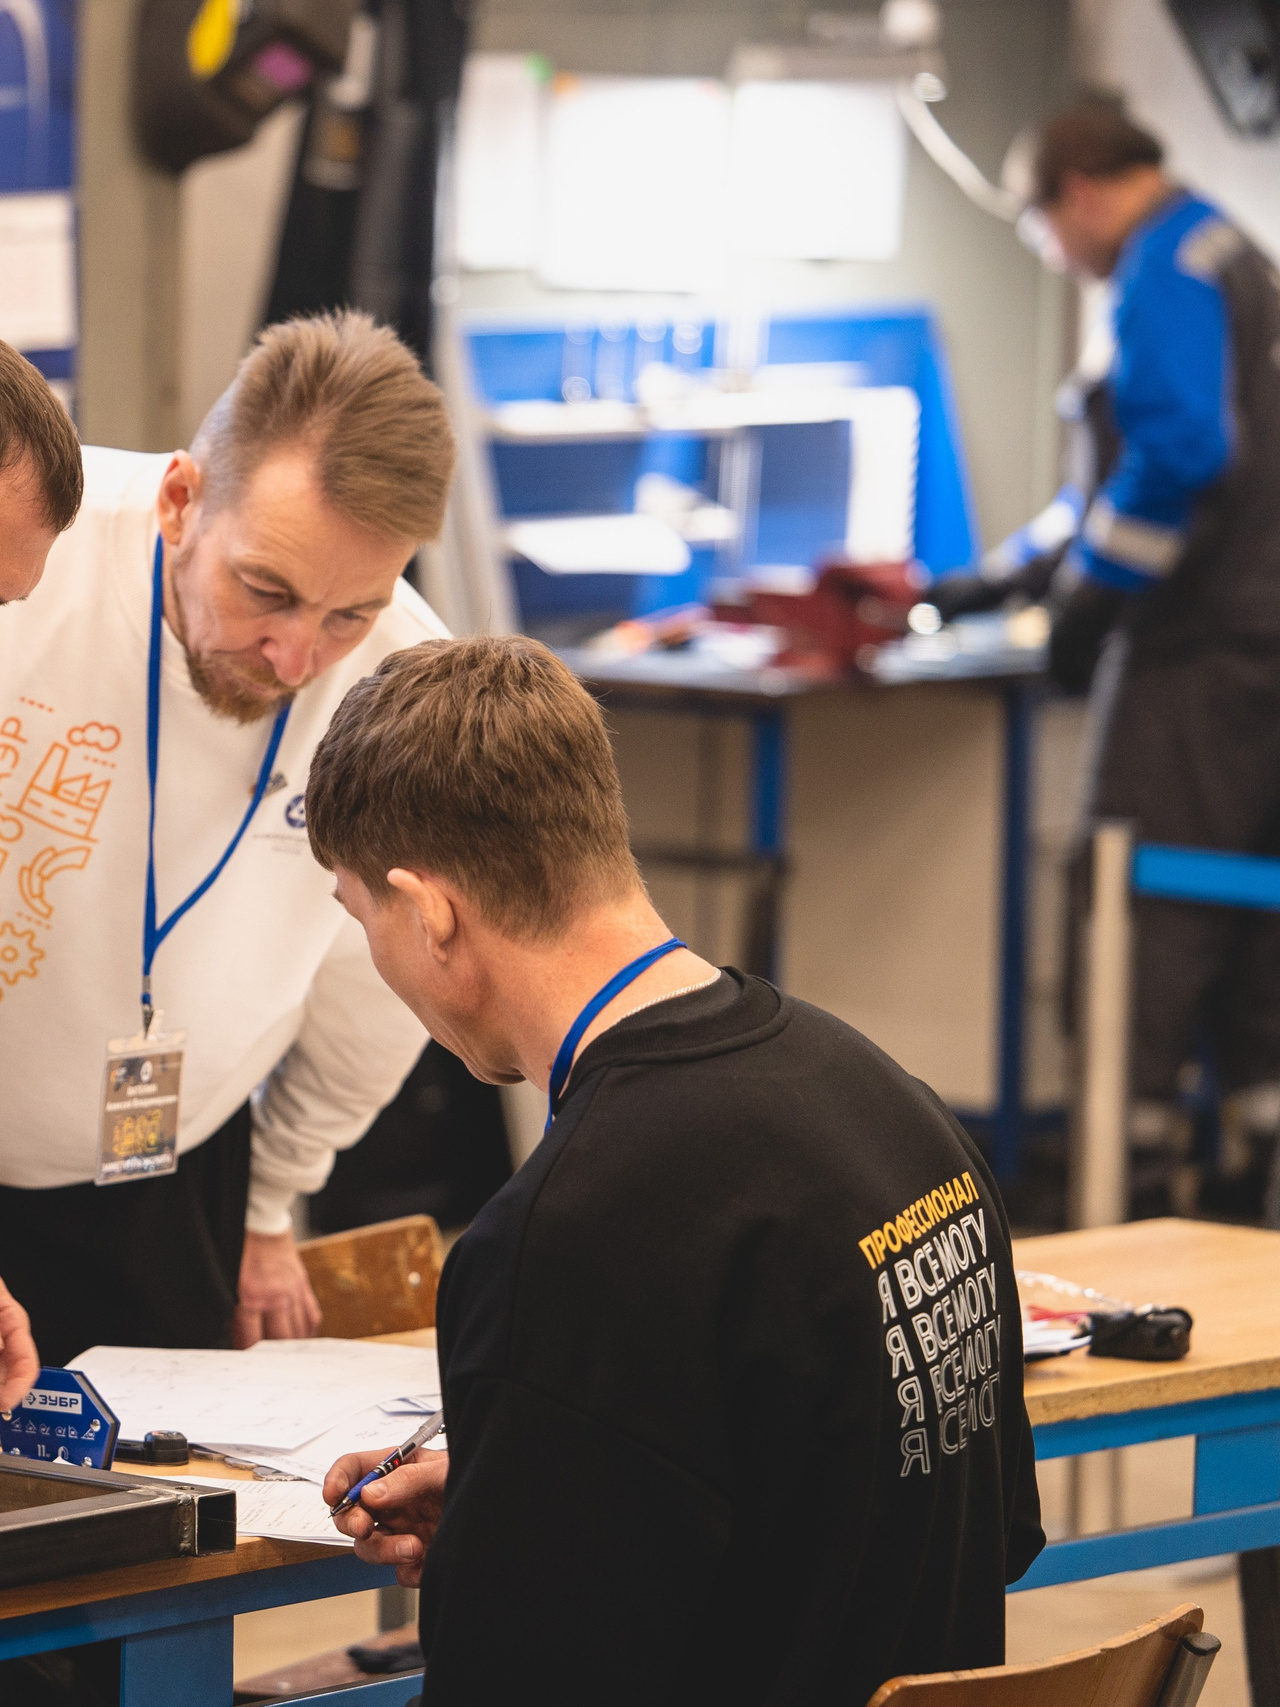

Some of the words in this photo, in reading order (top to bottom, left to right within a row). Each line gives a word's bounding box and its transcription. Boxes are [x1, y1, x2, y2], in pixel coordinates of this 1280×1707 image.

[858, 1171, 980, 1270] ПРОФЕССИОНАЛ
[878, 1270, 898, 1324] Я
[886, 1324, 915, 1379] Я
[38, 1394, 79, 1408] ЗУБР
[897, 1375, 925, 1428] Я
[900, 1427, 931, 1478] Я
